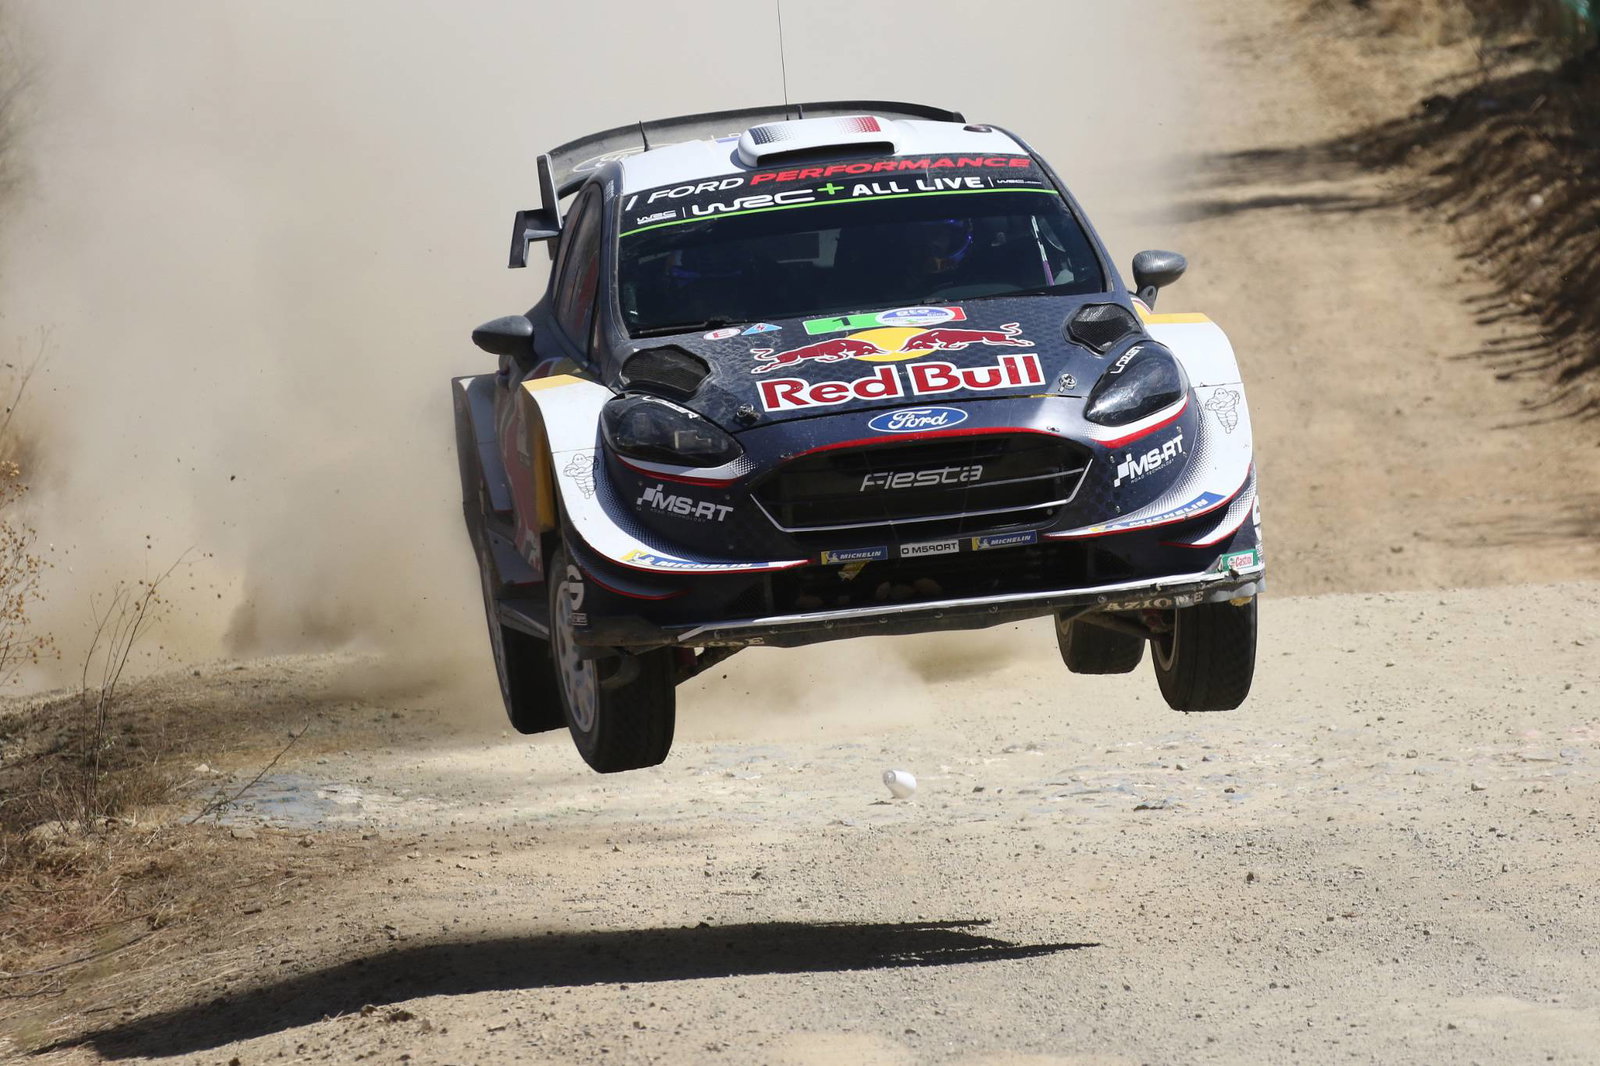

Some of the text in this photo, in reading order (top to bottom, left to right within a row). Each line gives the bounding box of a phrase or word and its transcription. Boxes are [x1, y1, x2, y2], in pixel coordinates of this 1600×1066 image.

[647, 177, 744, 204] FORD
[750, 157, 1031, 185] PERFORMANCE
[852, 181, 909, 197] ALL
[916, 177, 984, 191] LIVE
[832, 317, 851, 327] 1
[758, 354, 1043, 411] Red Bull
[887, 410, 947, 428] Ford
[860, 464, 984, 492] Fiesta
[1129, 499, 1209, 526] MICHELIN
[990, 534, 1031, 546] MICHELIN
[839, 550, 882, 560] MICHELIN
